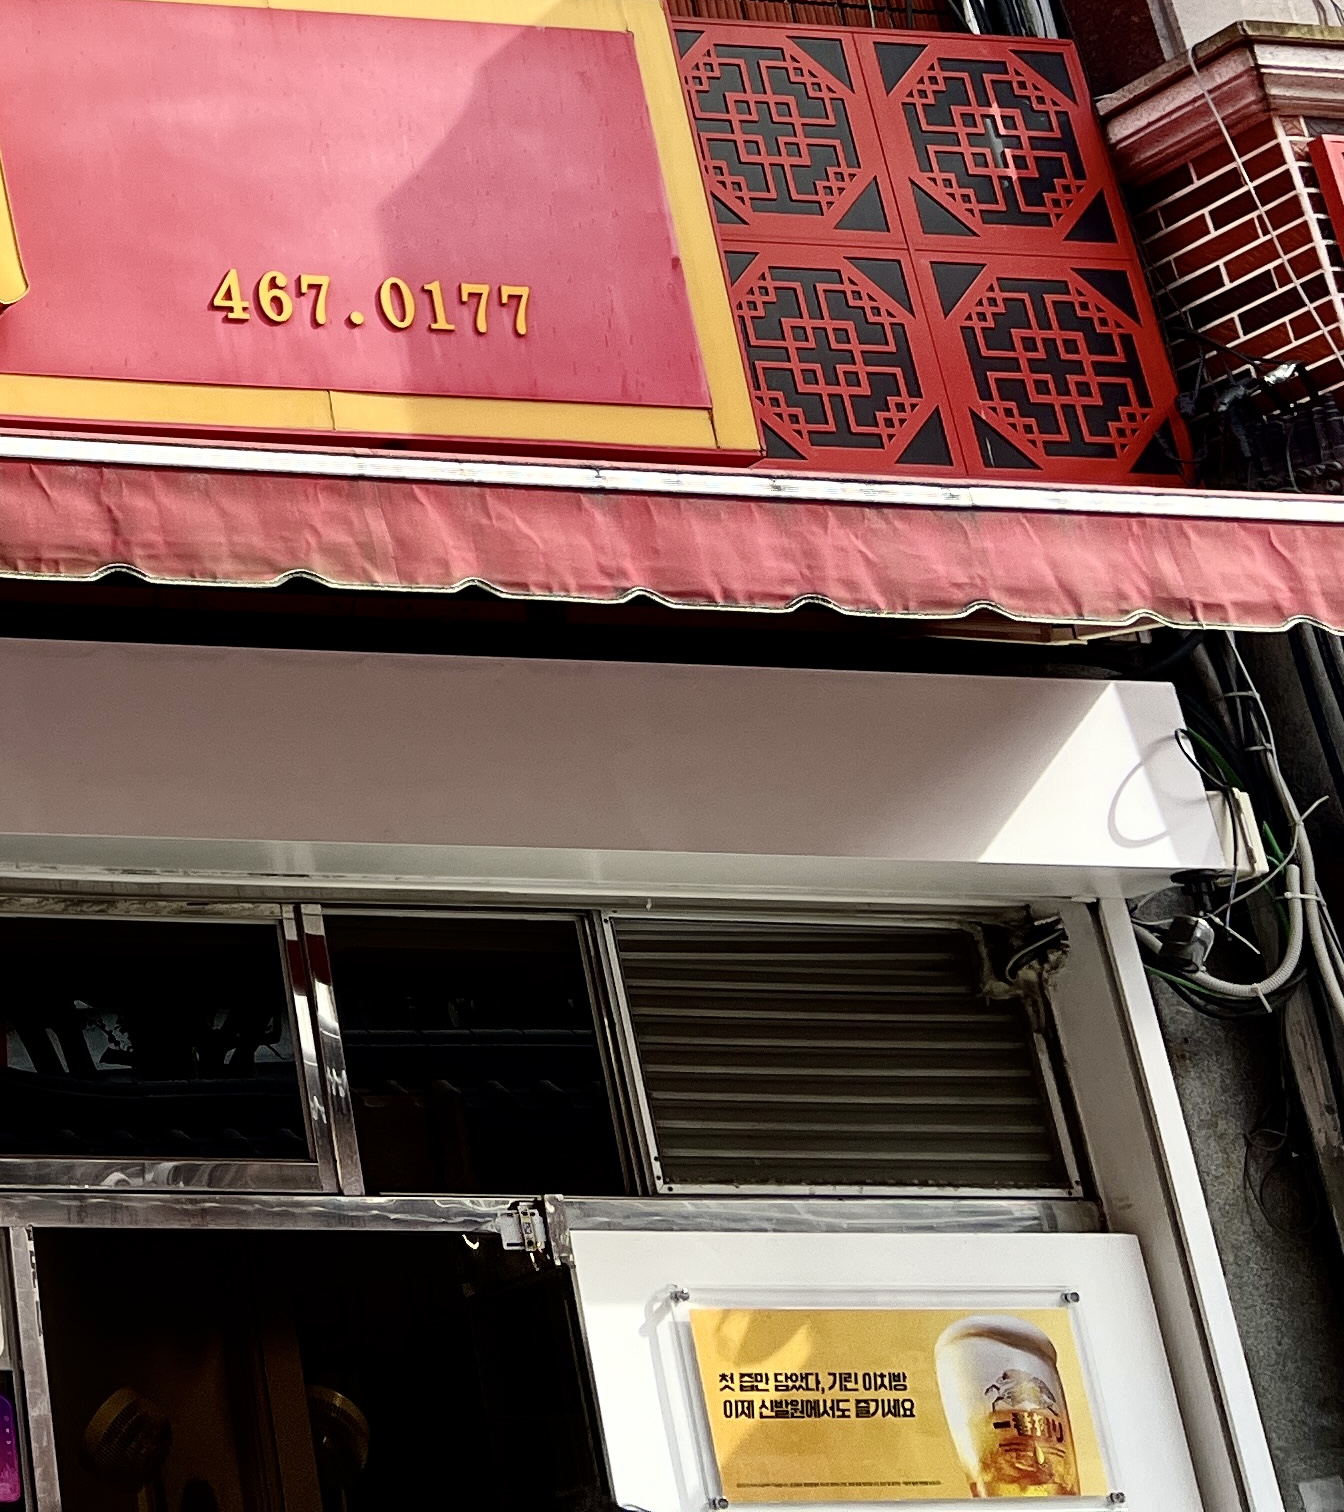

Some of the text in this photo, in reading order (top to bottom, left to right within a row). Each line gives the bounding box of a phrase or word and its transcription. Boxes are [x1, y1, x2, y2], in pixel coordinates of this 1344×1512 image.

[212, 268, 530, 336] 467.0177
[718, 1372, 736, 1393] 첫
[774, 1372, 825, 1395] 담았다,
[827, 1372, 859, 1393] 기린
[862, 1372, 909, 1393] 이치방
[723, 1398, 916, 1420] 이제 신발원에서도 즐기세요
